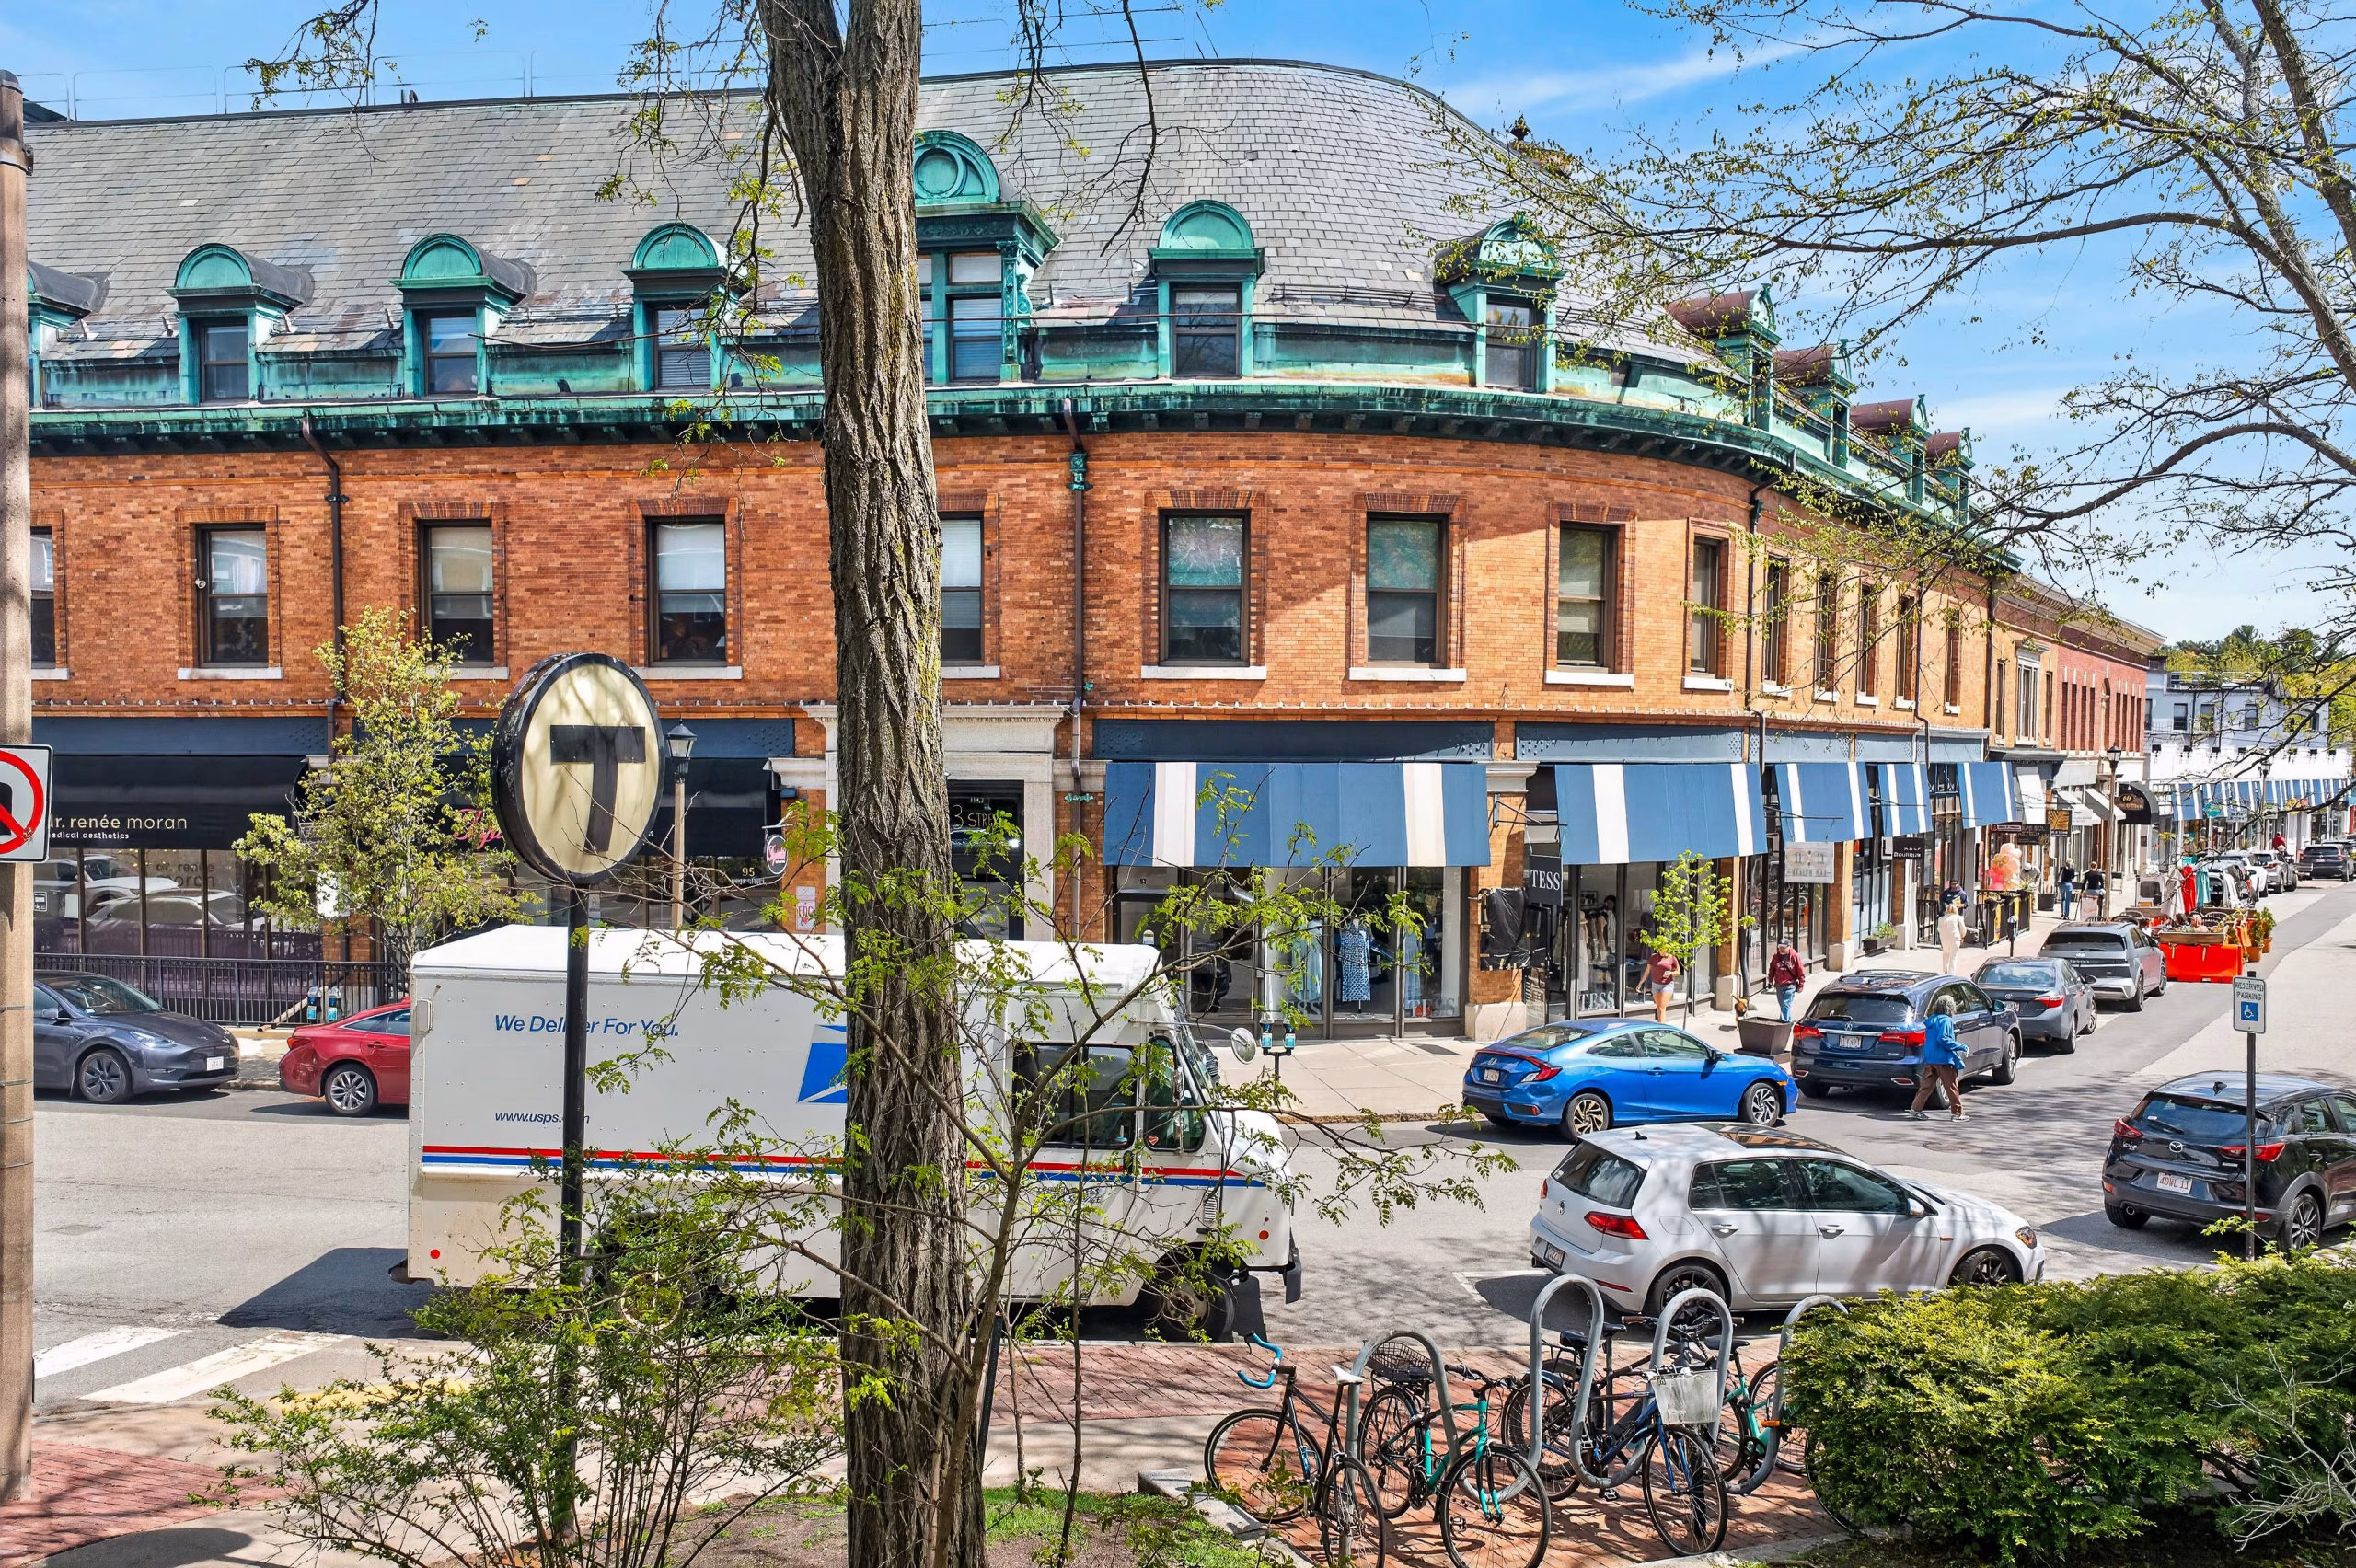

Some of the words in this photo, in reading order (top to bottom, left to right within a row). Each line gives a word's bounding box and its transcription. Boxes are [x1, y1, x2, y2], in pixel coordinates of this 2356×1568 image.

[550, 725, 646, 852] T
[50, 814, 65, 828] r.
[70, 814, 121, 828] renée
[127, 817, 188, 829] moran
[742, 867, 756, 877] 95
[1530, 870, 1561, 891] TESS
[1578, 991, 1616, 1011] TESS
[495, 1015, 525, 1032] We
[529, 1015, 600, 1033] Delir
[603, 1018, 637, 1034] For
[641, 1019, 679, 1037] You.
[495, 1112, 590, 1124] www.usps.
